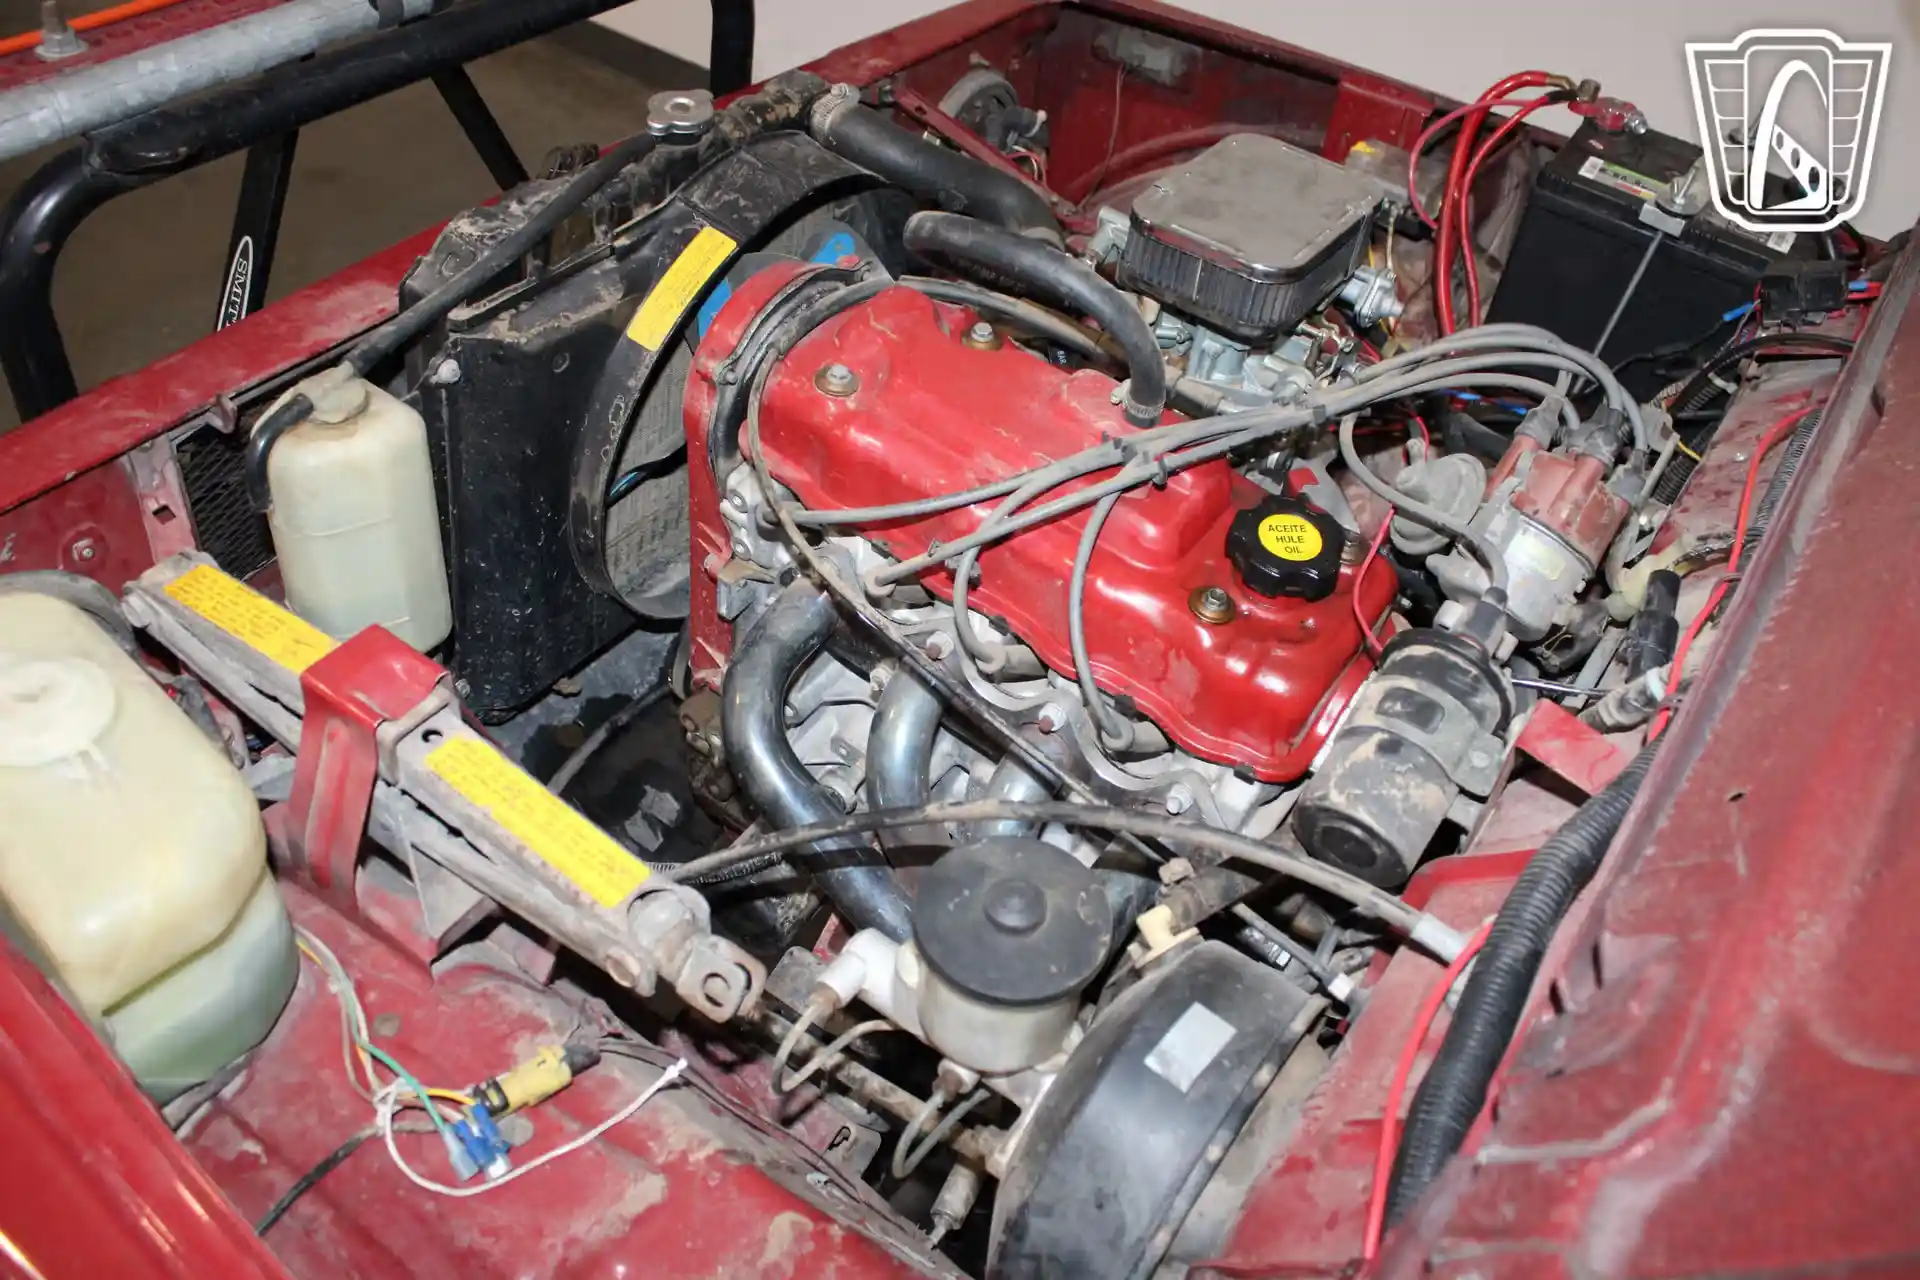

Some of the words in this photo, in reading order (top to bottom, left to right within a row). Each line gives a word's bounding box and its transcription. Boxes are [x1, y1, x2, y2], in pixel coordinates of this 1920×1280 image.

[225, 258, 248, 328] SMIT
[1268, 524, 1306, 533] ACEITE
[1275, 535, 1305, 544] HULE
[1284, 546, 1303, 554] OIL
